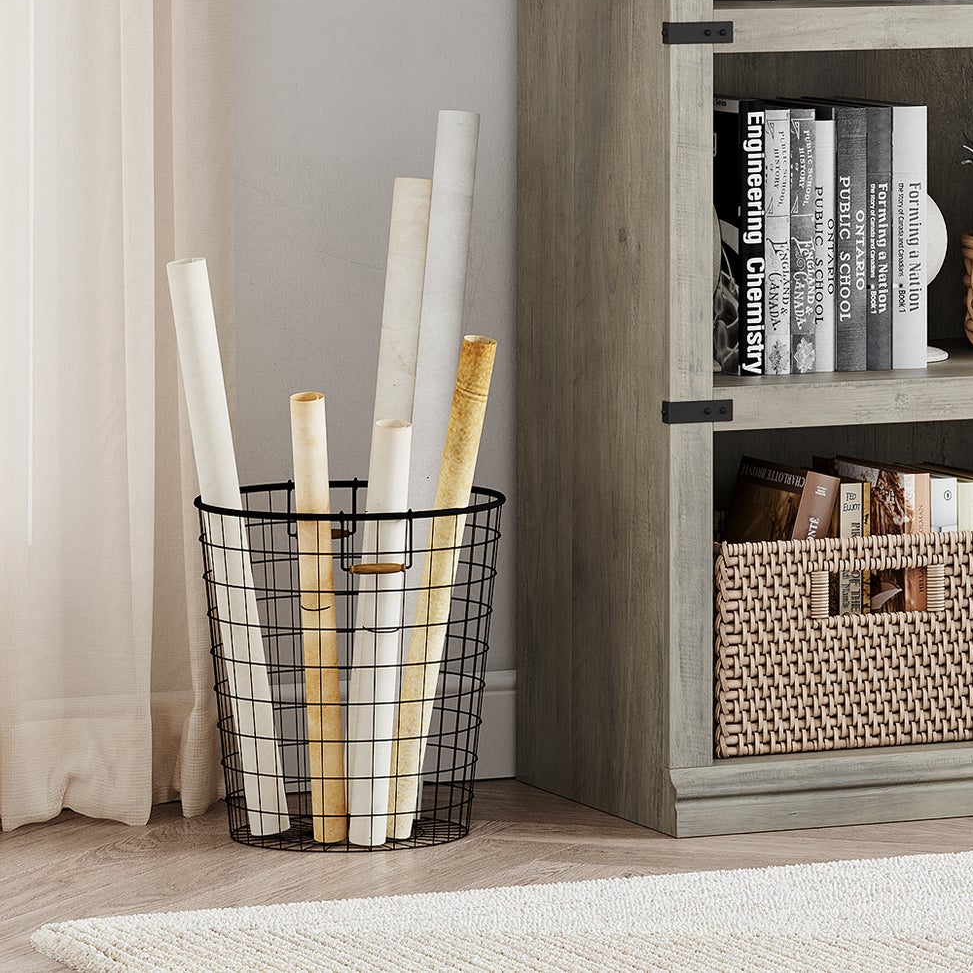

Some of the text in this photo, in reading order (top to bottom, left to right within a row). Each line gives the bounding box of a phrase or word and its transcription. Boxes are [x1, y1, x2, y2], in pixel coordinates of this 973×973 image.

[778, 131, 788, 207] PUBLIC SCHOOL
[798, 148, 806, 189] HISTORY
[803, 130, 814, 207] PUBLIC SCHOOL
[743, 111, 765, 374] Engineering Chemistry
[766, 238, 790, 316] ENGLAND &
[791, 237, 815, 315] ENGLAND &
[815, 186, 823, 324] PUBLIC SCHOOL
[839, 176, 851, 322] PUBLIC SCHOOL
[855, 210, 865, 290] ONTARIO
[877, 183, 888, 313] Forming a Nation
[906, 183, 922, 312] Forming a Nation
[898, 290, 906, 308] Book
[765, 469, 805, 488] CHARLOTTE
[846, 492, 856, 501] TED
[851, 589, 860, 612] THE
